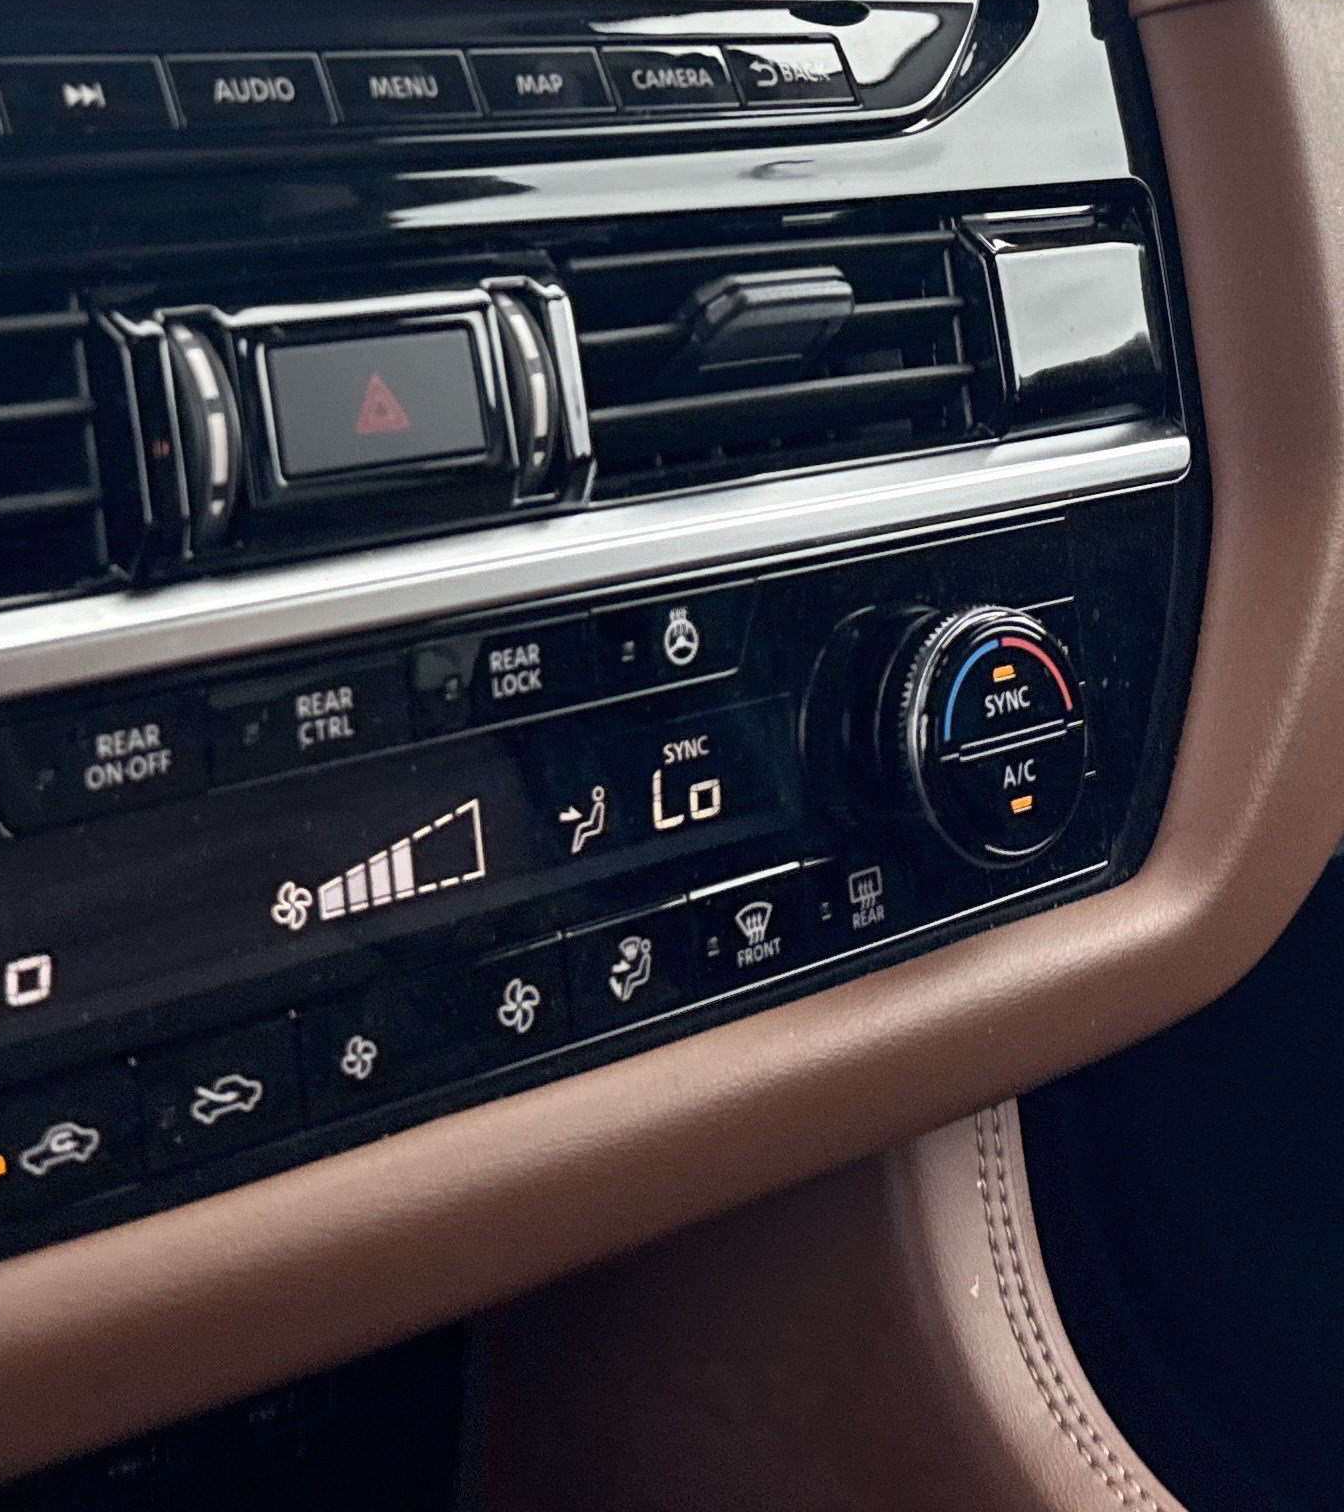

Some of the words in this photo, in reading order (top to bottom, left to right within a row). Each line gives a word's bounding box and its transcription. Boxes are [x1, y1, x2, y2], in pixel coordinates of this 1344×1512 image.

[212, 75, 296, 104] AUDIO
[369, 71, 439, 101] MENU
[516, 72, 564, 96] MAP
[631, 66, 713, 92] CAMERA
[488, 642, 541, 675] REAR
[490, 668, 543, 700] LOCK
[295, 686, 354, 721] REAR
[984, 685, 1032, 720] SYNC
[94, 723, 161, 760] REAR
[297, 717, 356, 751] CTRL
[662, 734, 710, 766] SYNC
[1002, 758, 1037, 790] A/C
[652, 768, 721, 831] Lo
[852, 904, 885, 929] REAR
[736, 936, 782, 968] FRONT
